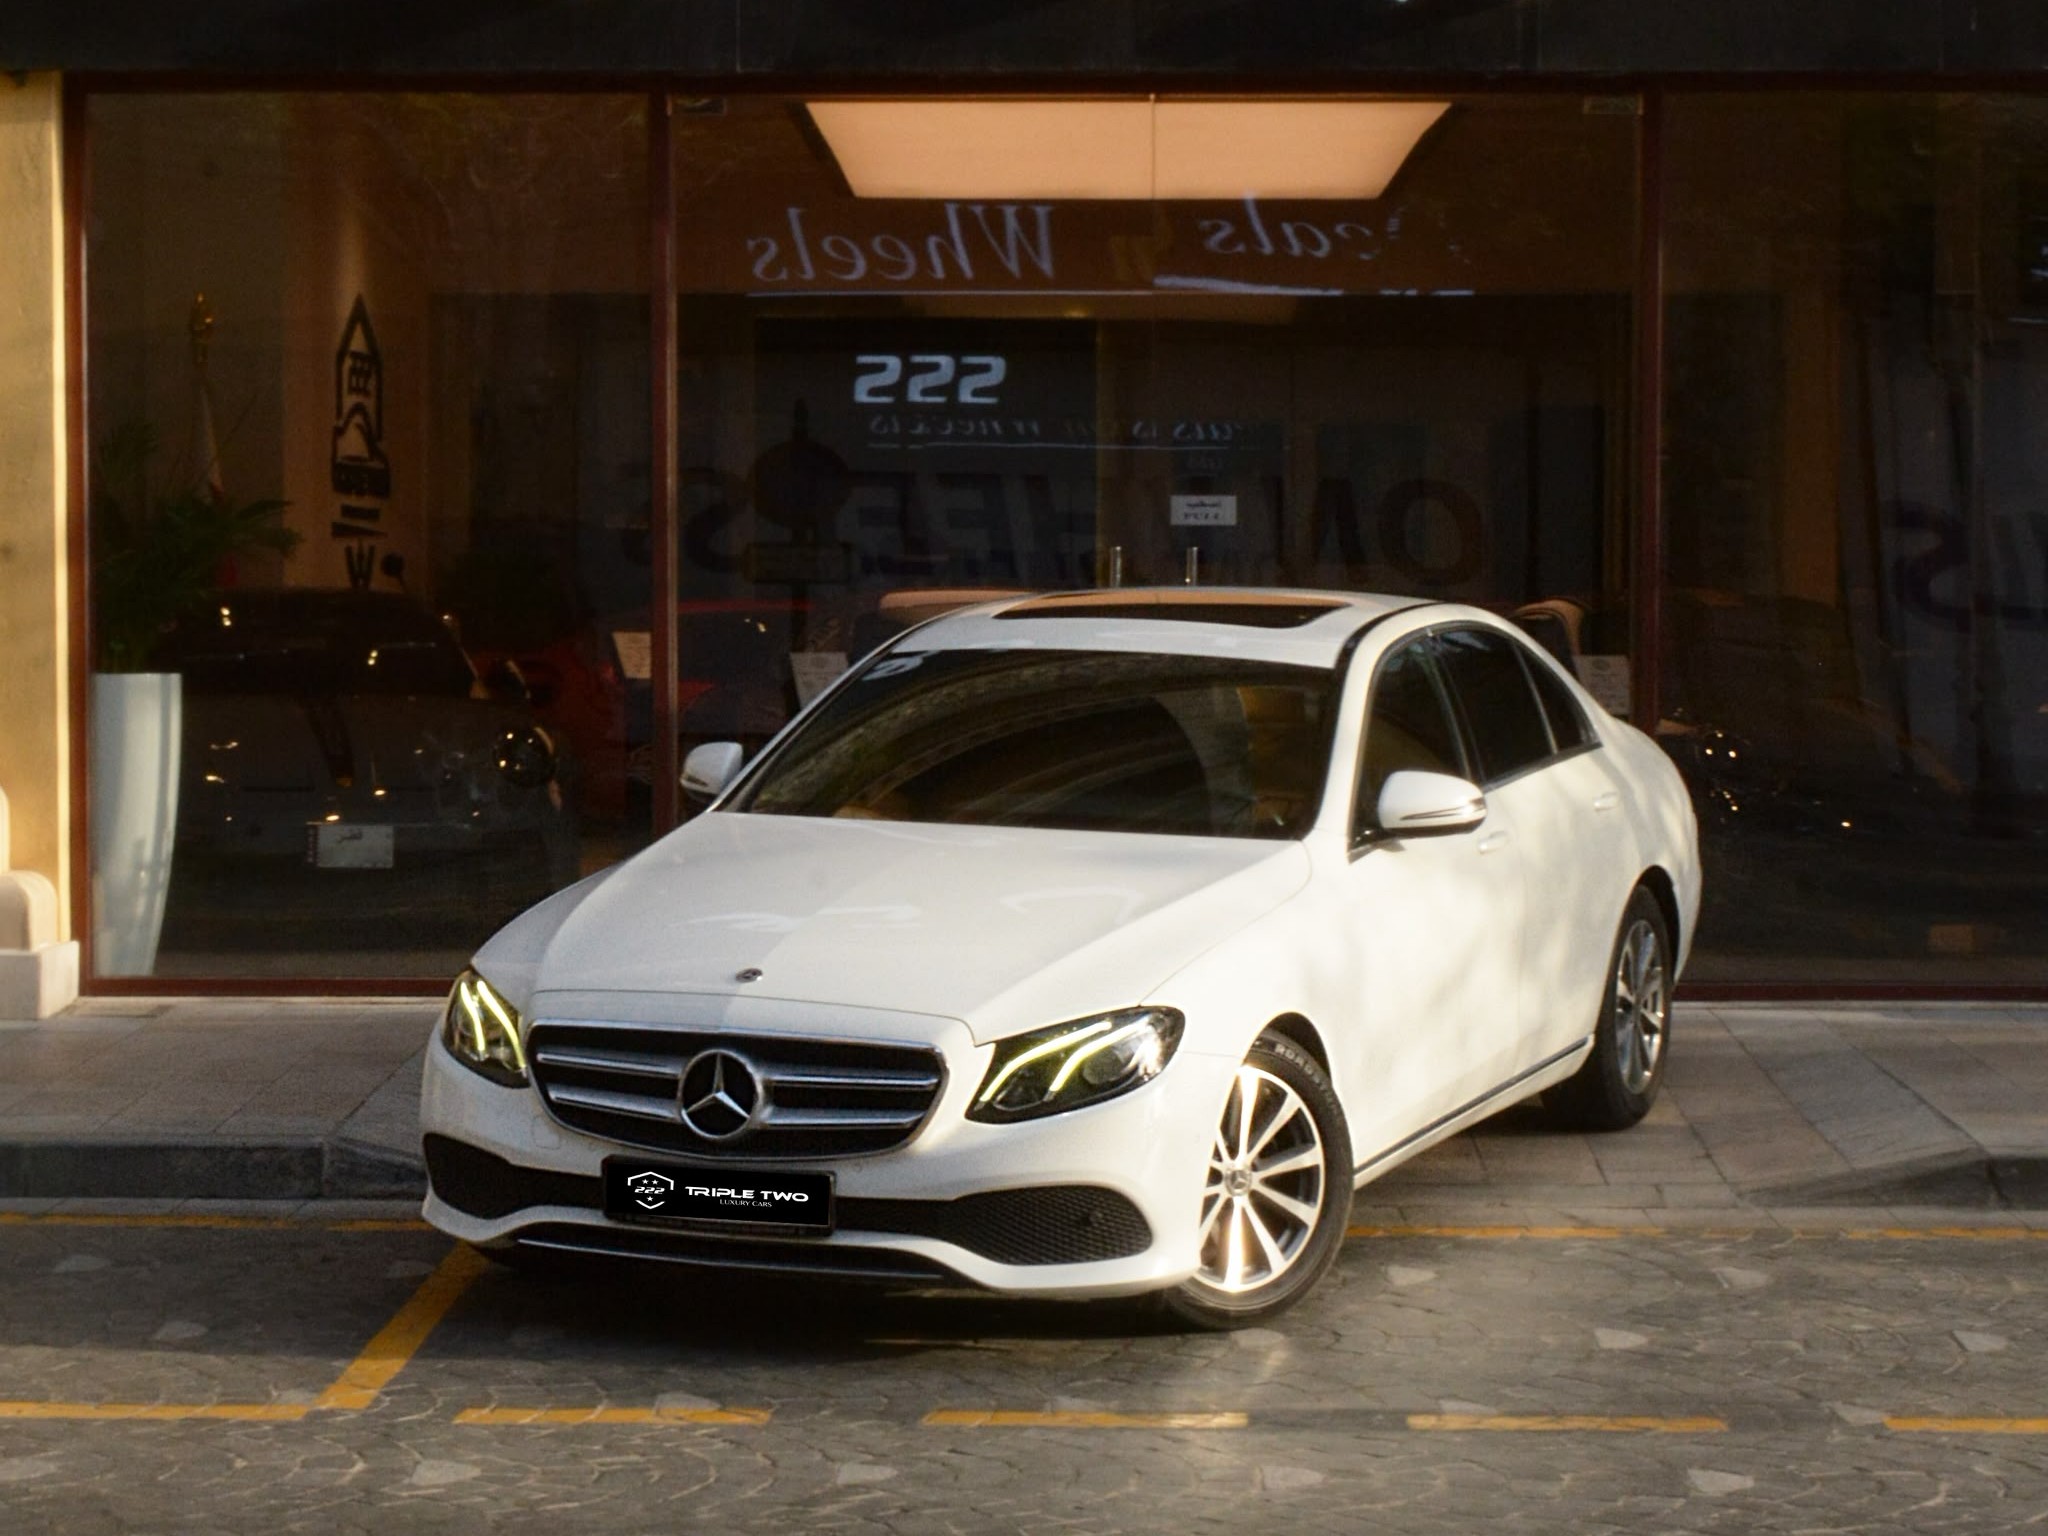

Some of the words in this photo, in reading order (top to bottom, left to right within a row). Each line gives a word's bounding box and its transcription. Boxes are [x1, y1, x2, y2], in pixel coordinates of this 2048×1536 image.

[633, 1185, 665, 1195] 222
[685, 1186, 755, 1199] TRIPLE
[760, 1190, 809, 1202] TWO
[719, 1199, 750, 1207] LUXURY
[751, 1200, 773, 1208] CARS
